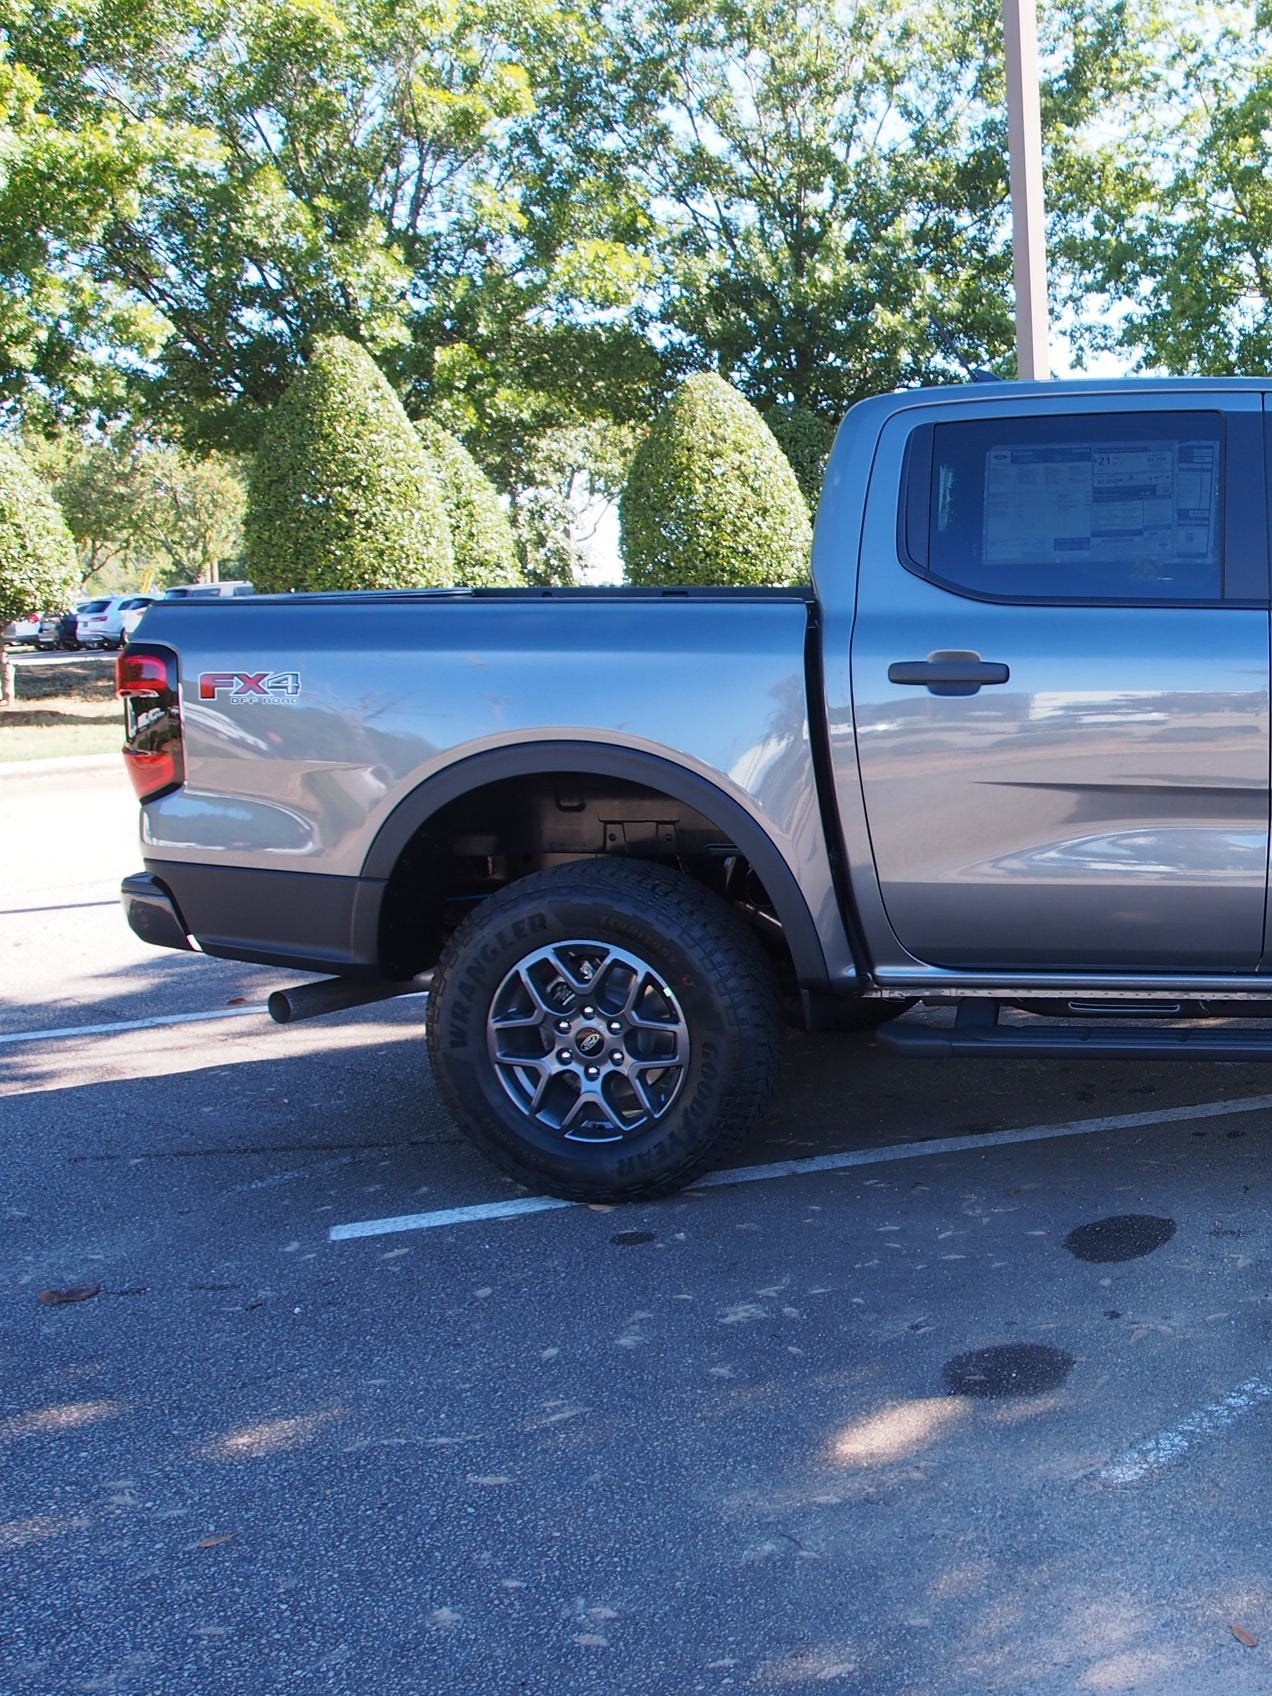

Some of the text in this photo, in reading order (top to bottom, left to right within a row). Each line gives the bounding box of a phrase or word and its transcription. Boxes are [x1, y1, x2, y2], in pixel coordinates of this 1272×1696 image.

[1098, 456, 1110, 466] 21
[199, 672, 301, 701] FX4
[230, 697, 258, 705] OFF
[449, 912, 548, 1049] WRANGLER
[617, 1041, 718, 1177] GOODYEAR
